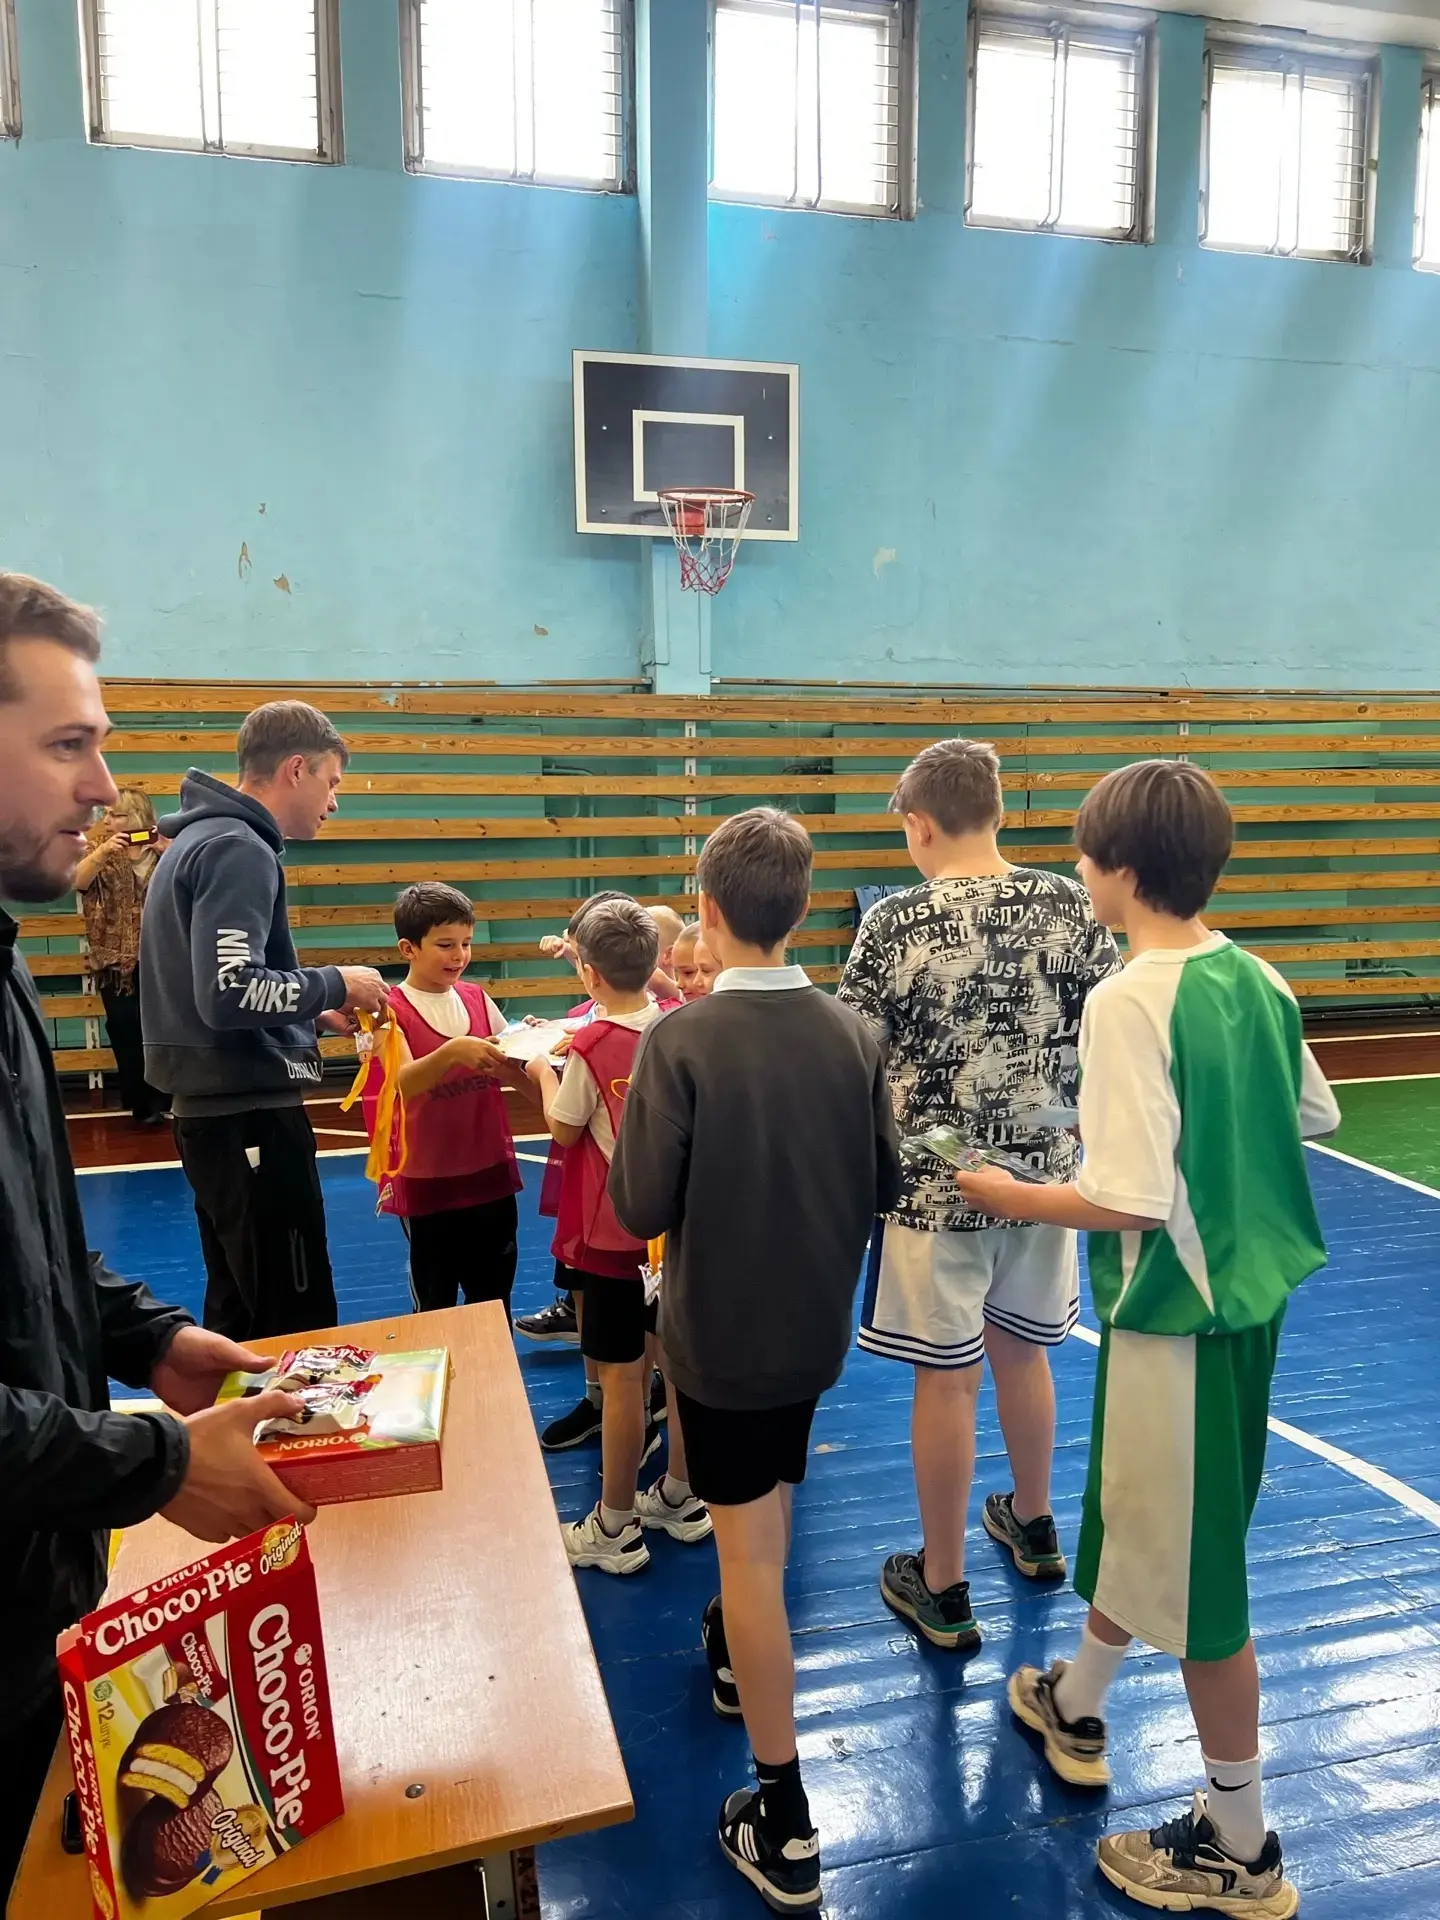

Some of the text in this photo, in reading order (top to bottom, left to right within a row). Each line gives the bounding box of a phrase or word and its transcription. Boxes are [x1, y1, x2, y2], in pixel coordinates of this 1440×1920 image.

[239, 978, 301, 1013] NIKE
[985, 1088, 1017, 1101] WAS
[938, 1185, 961, 1193] JUS
[279, 1435, 345, 1451] ORION
[98, 1701, 114, 1725] 12
[299, 1668, 321, 1740] ORION
[210, 1808, 265, 1868] Original
